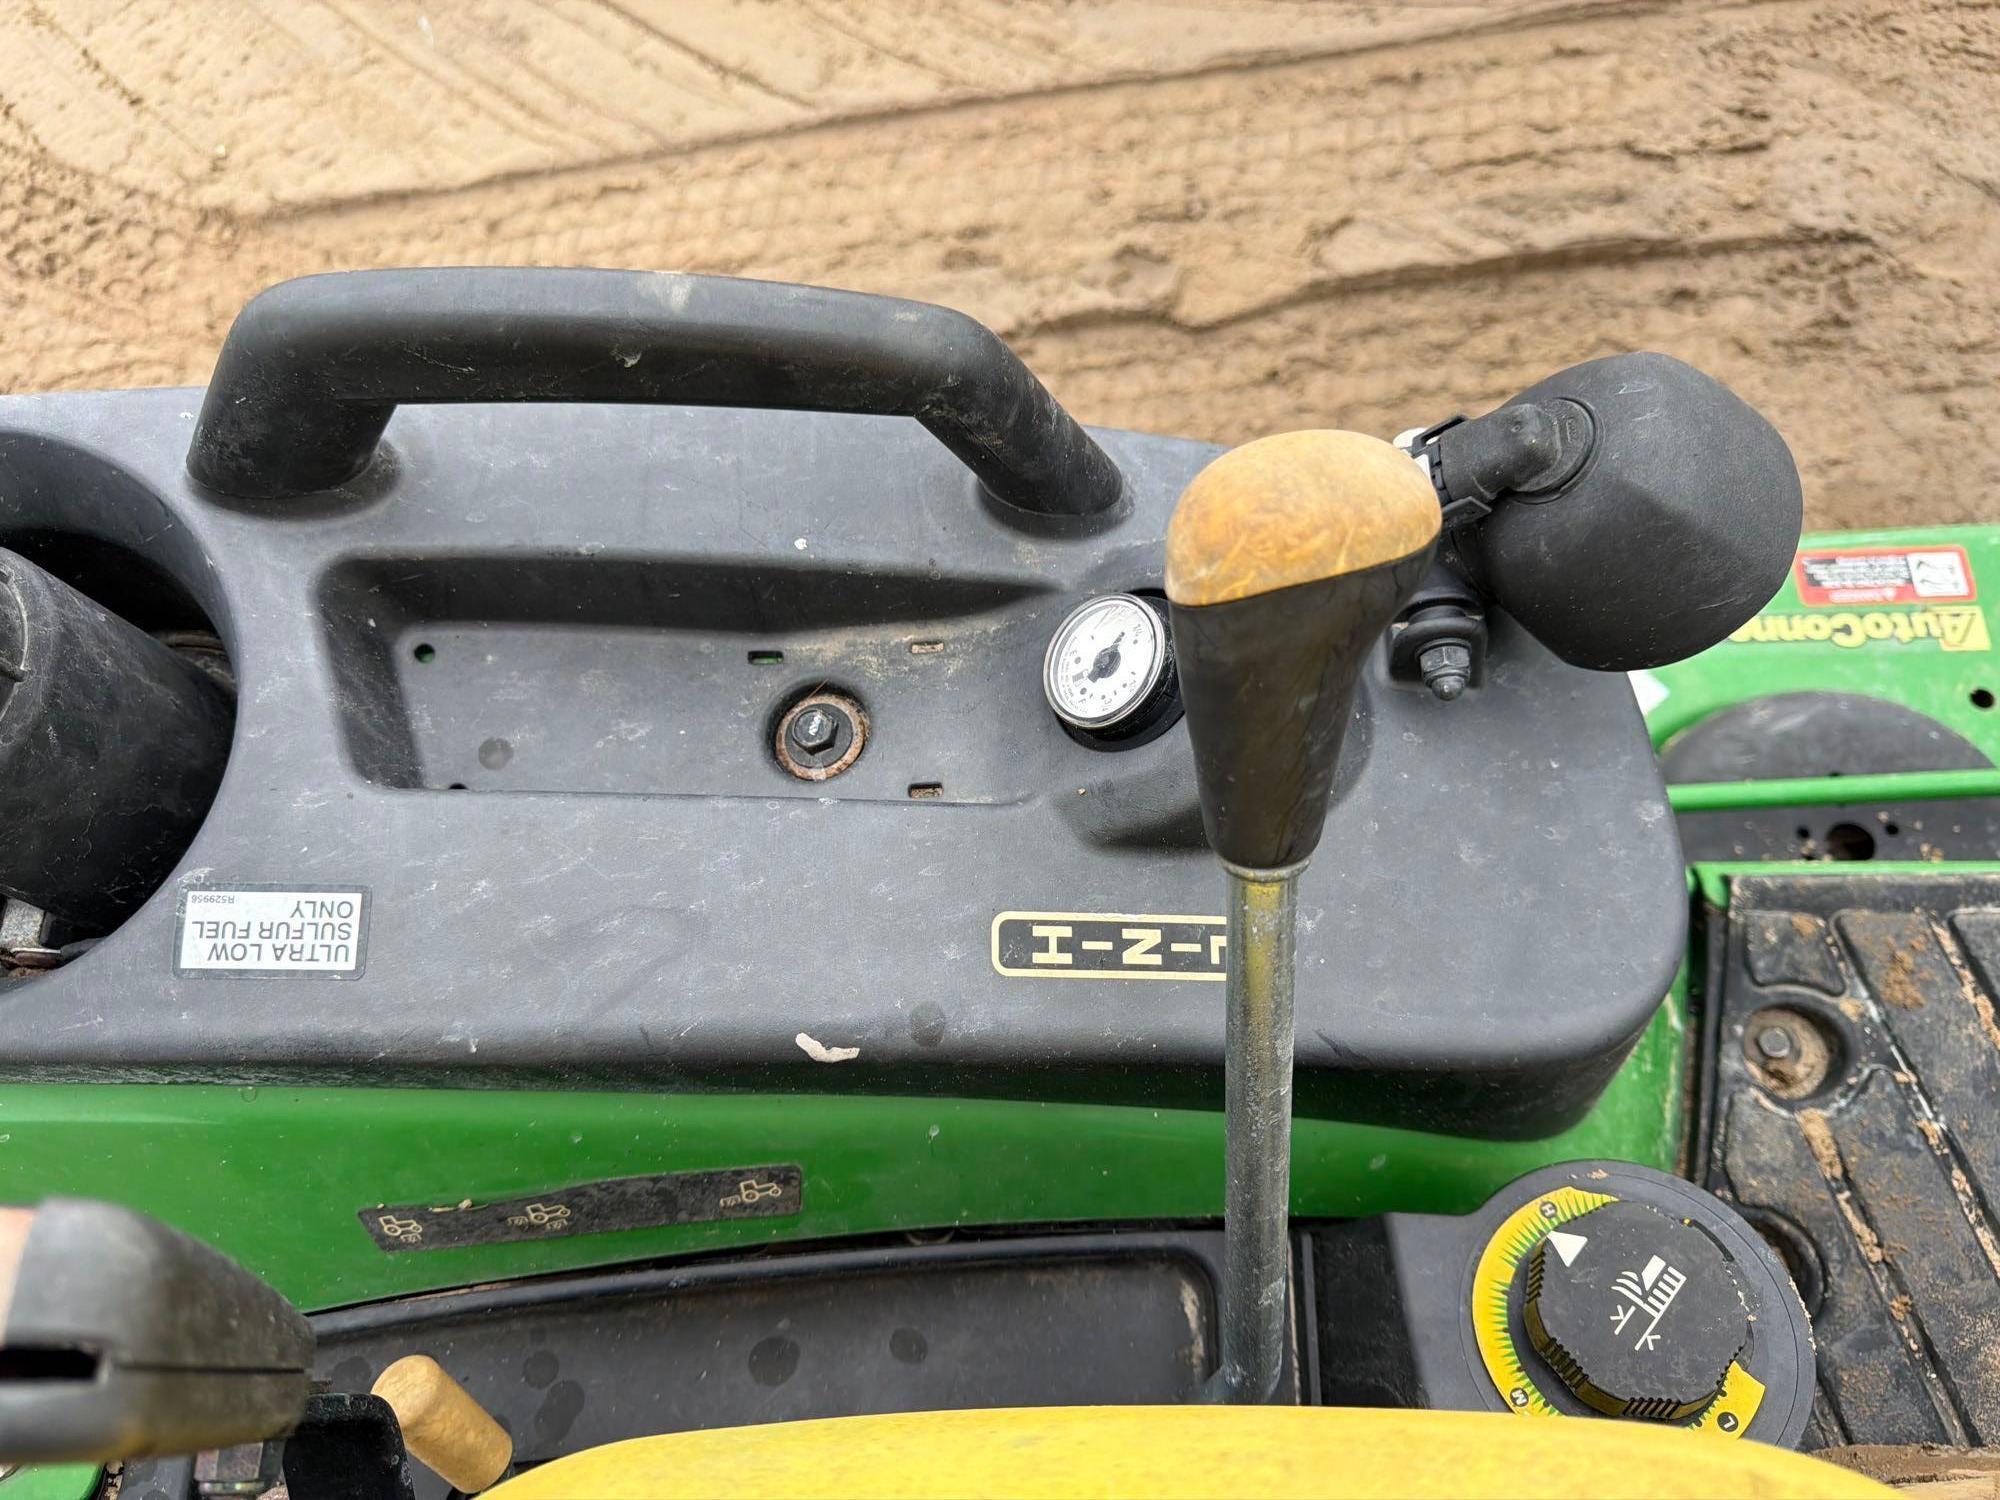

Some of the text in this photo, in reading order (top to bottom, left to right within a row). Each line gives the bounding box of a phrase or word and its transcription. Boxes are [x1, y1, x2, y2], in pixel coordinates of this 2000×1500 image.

[191, 894, 235, 904] R529956
[290, 900, 354, 919] ONLY
[191, 920, 352, 940] SULFUR FUEL
[207, 942, 350, 962] ULTRA LOW
[1542, 1204, 1555, 1217] H
[1513, 1391, 1526, 1406] M
[1723, 1415, 1736, 1430] L
